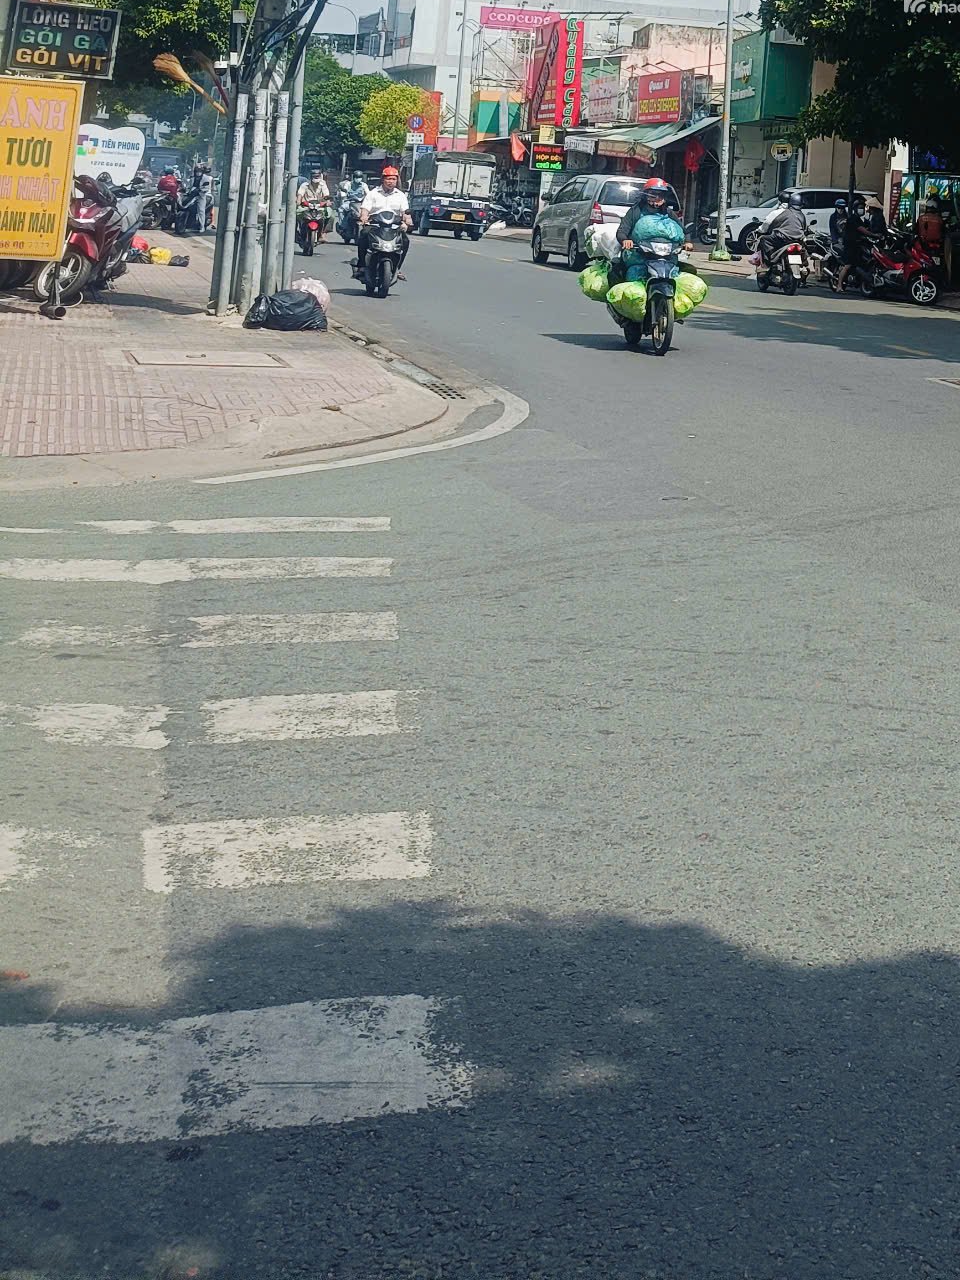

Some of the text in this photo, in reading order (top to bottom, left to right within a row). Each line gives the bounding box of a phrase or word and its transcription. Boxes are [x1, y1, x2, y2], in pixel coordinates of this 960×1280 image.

[15, 45, 107, 71] GỎI VỊT
[6, 136, 53, 168] TƯƠI
[117, 141, 140, 151] PHONG
[0, 206, 26, 232] ÁNH
